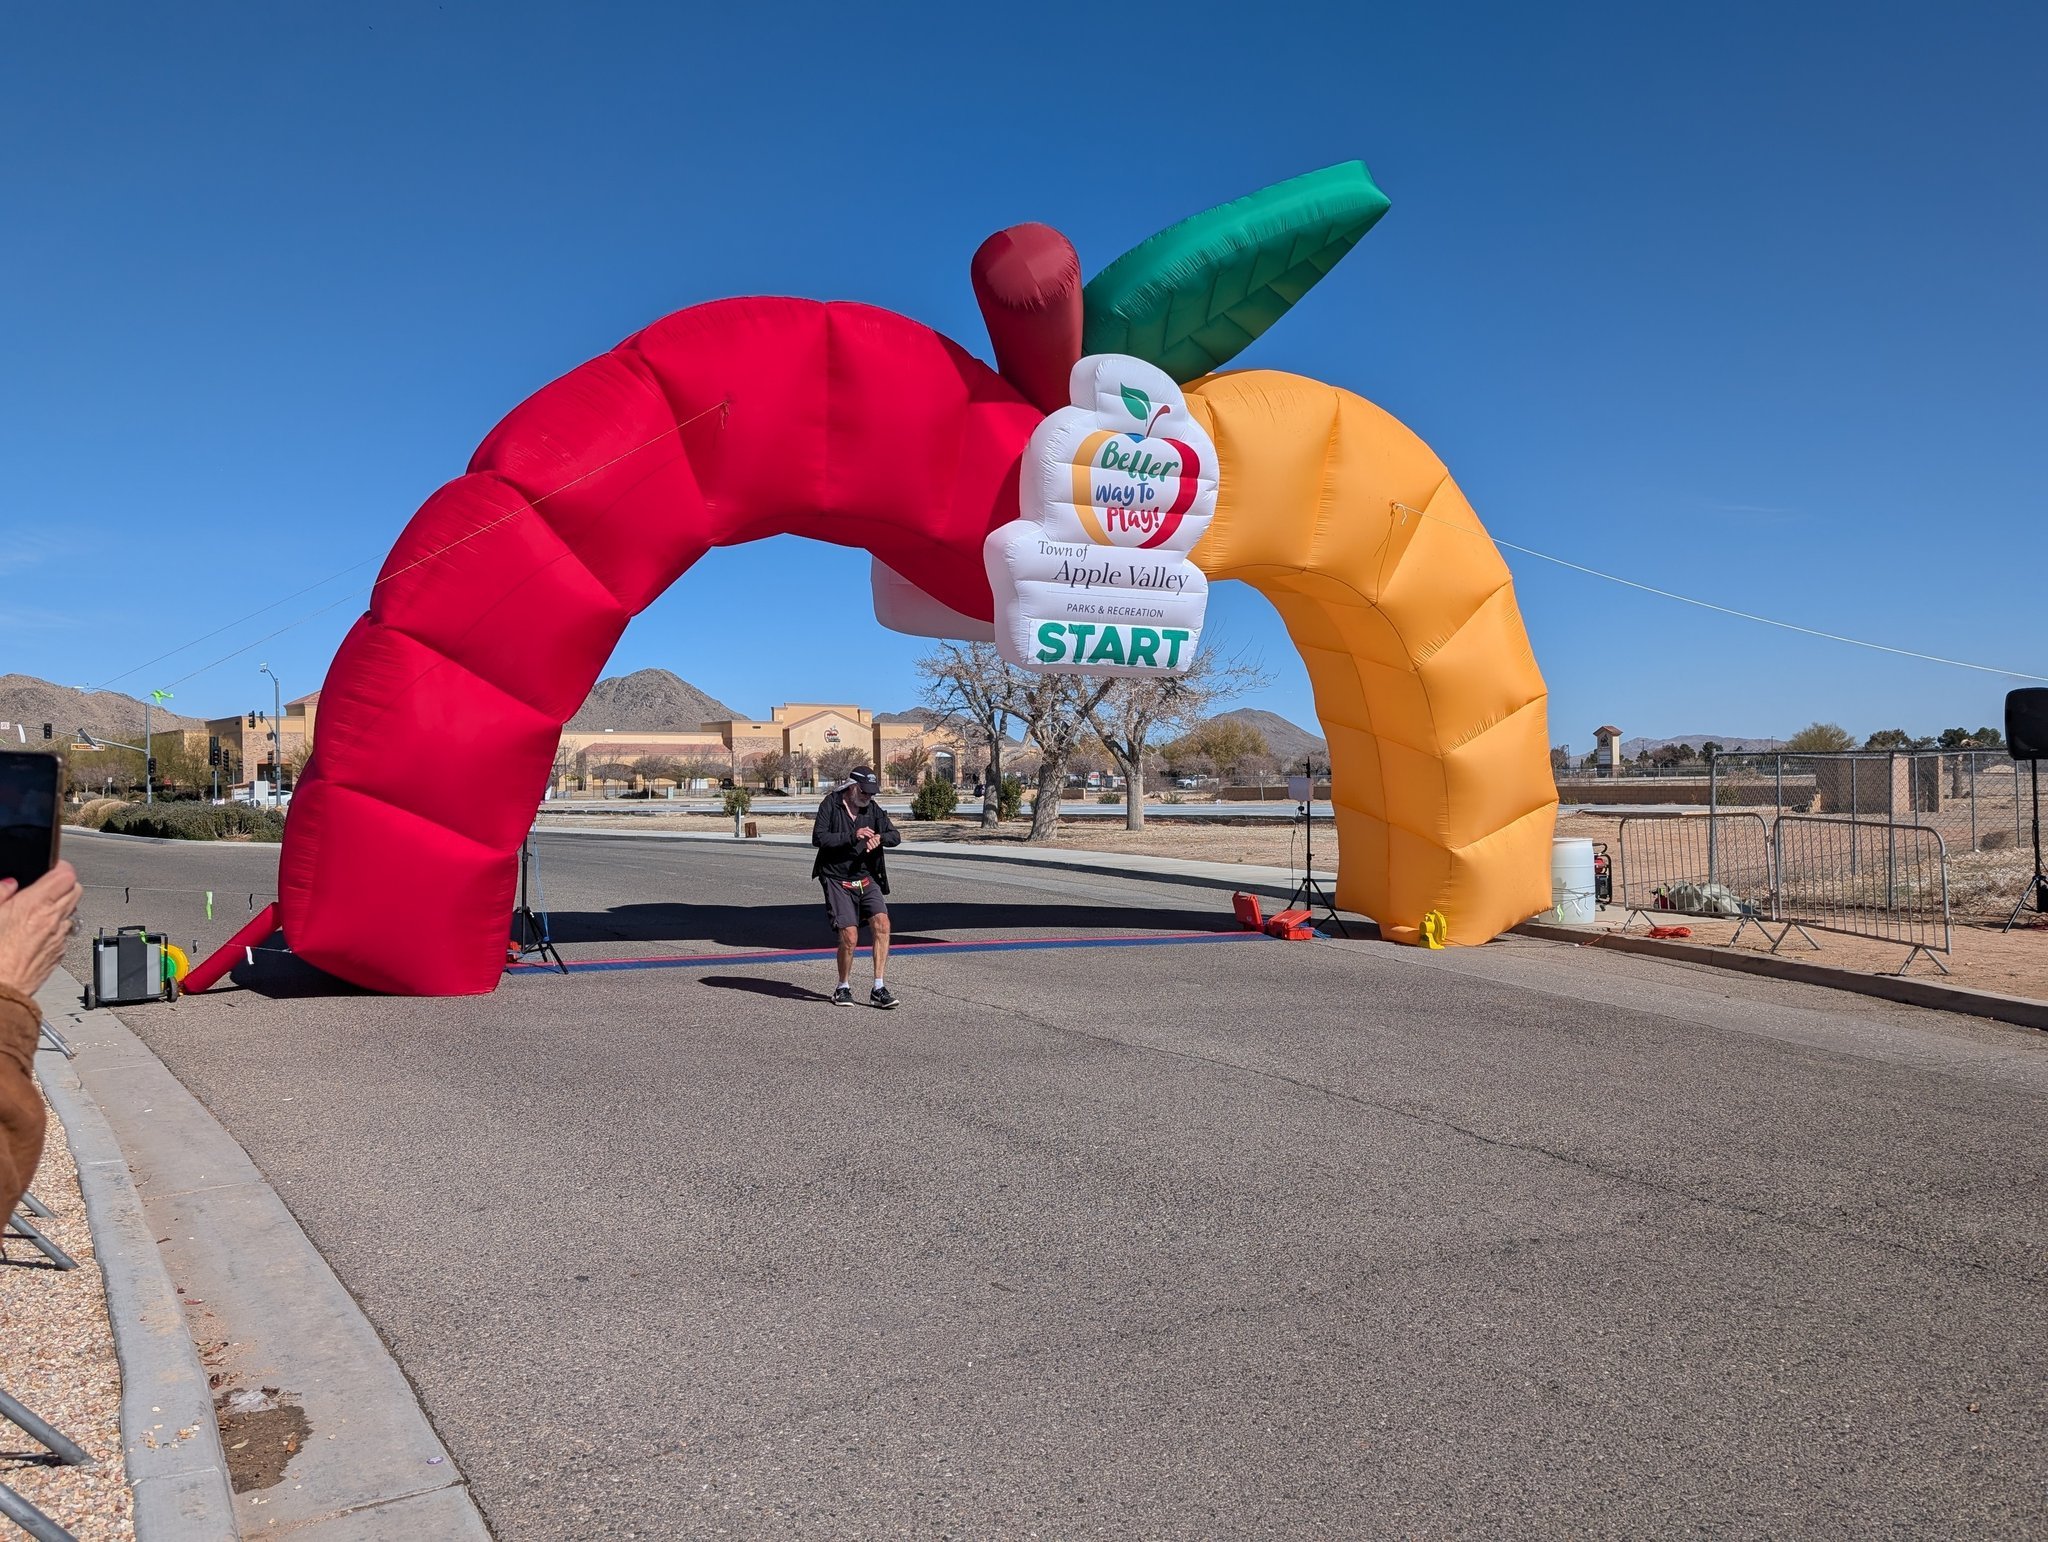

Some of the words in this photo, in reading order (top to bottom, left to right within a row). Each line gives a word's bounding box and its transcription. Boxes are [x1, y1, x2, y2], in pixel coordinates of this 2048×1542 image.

[1137, 483, 1154, 503] To
[1106, 507, 1159, 533] Play!
[1038, 541, 1073, 557] Town
[1076, 544, 1090, 562] of
[1052, 560, 1121, 589] Apple
[1128, 565, 1189, 595] Valley
[1066, 603, 1095, 614] PARKS
[1107, 607, 1164, 618] RECREATION
[1036, 622, 1190, 669] START
